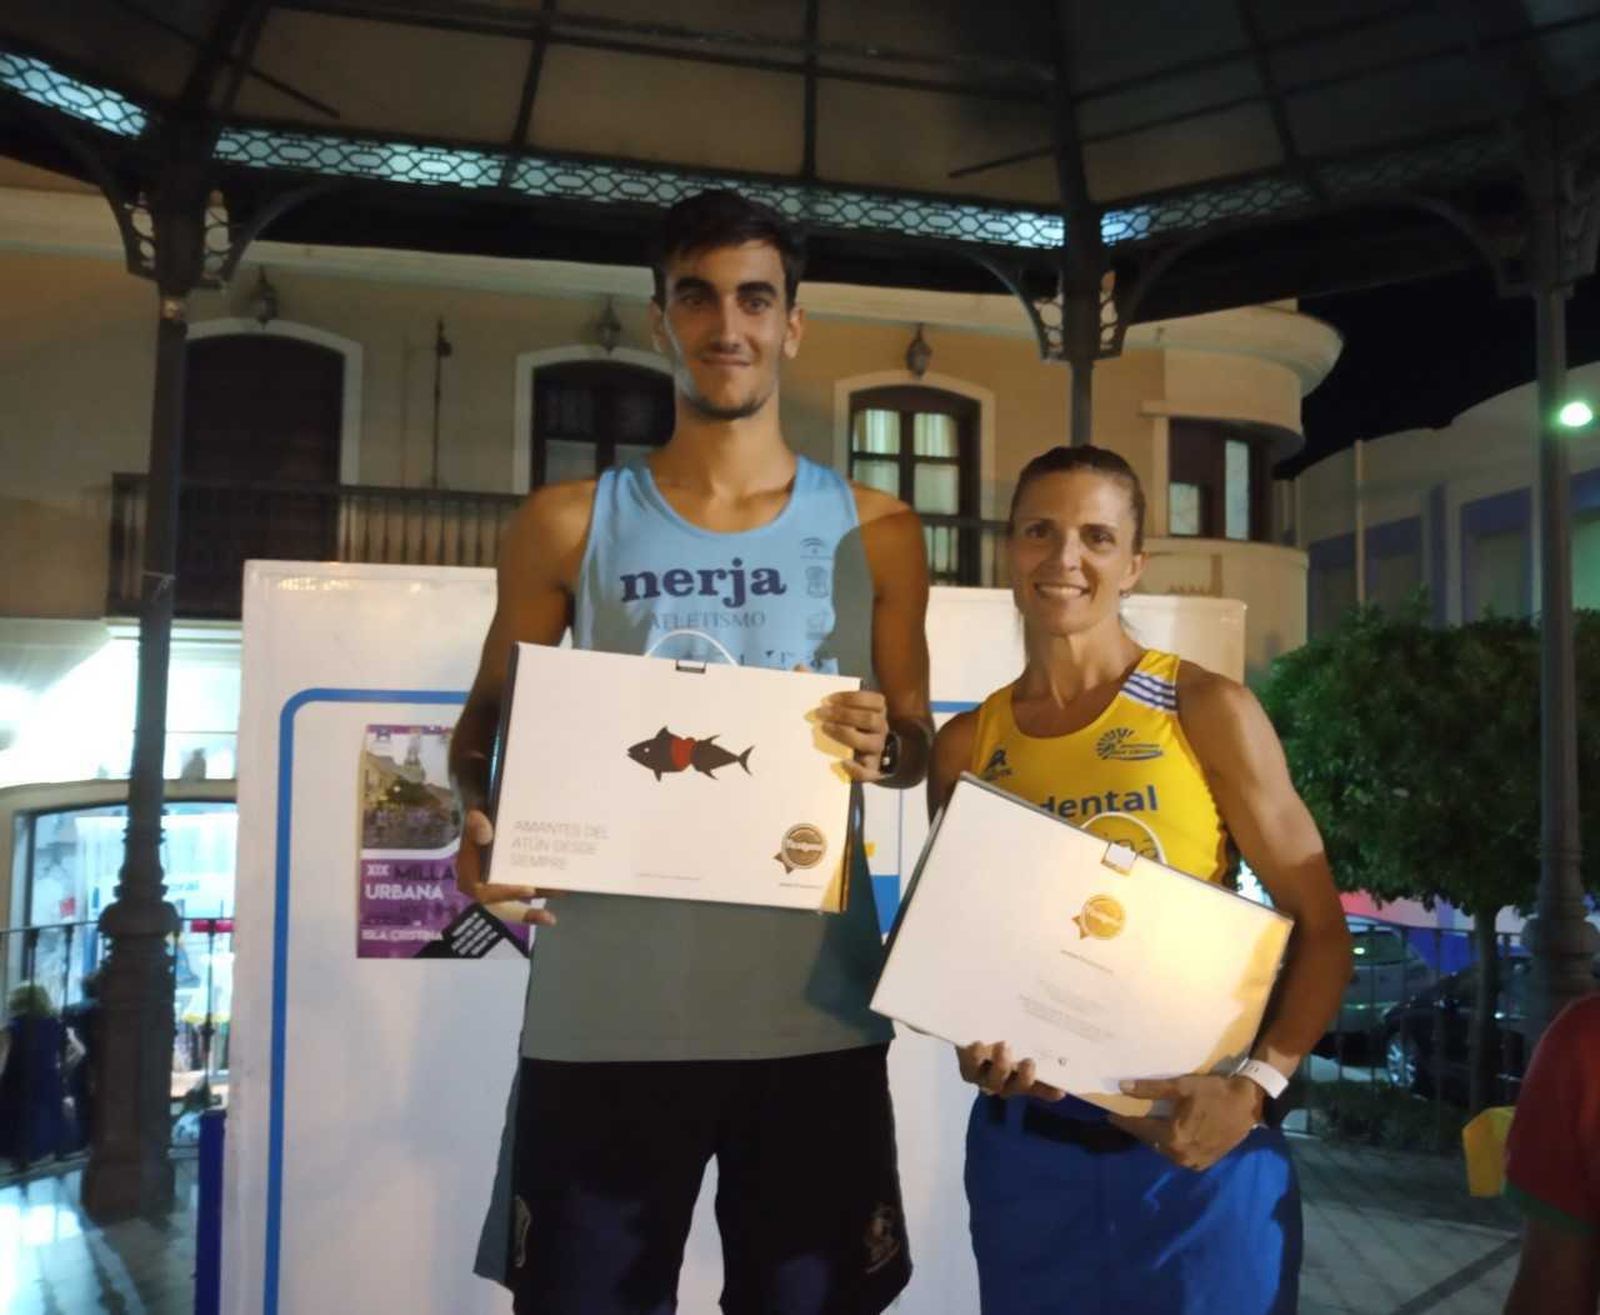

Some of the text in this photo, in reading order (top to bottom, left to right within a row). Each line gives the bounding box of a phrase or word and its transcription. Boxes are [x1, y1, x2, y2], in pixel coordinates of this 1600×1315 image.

[620, 557, 787, 609] nerja
[366, 864, 390, 877] XIX
[364, 883, 445, 901] URBANA
